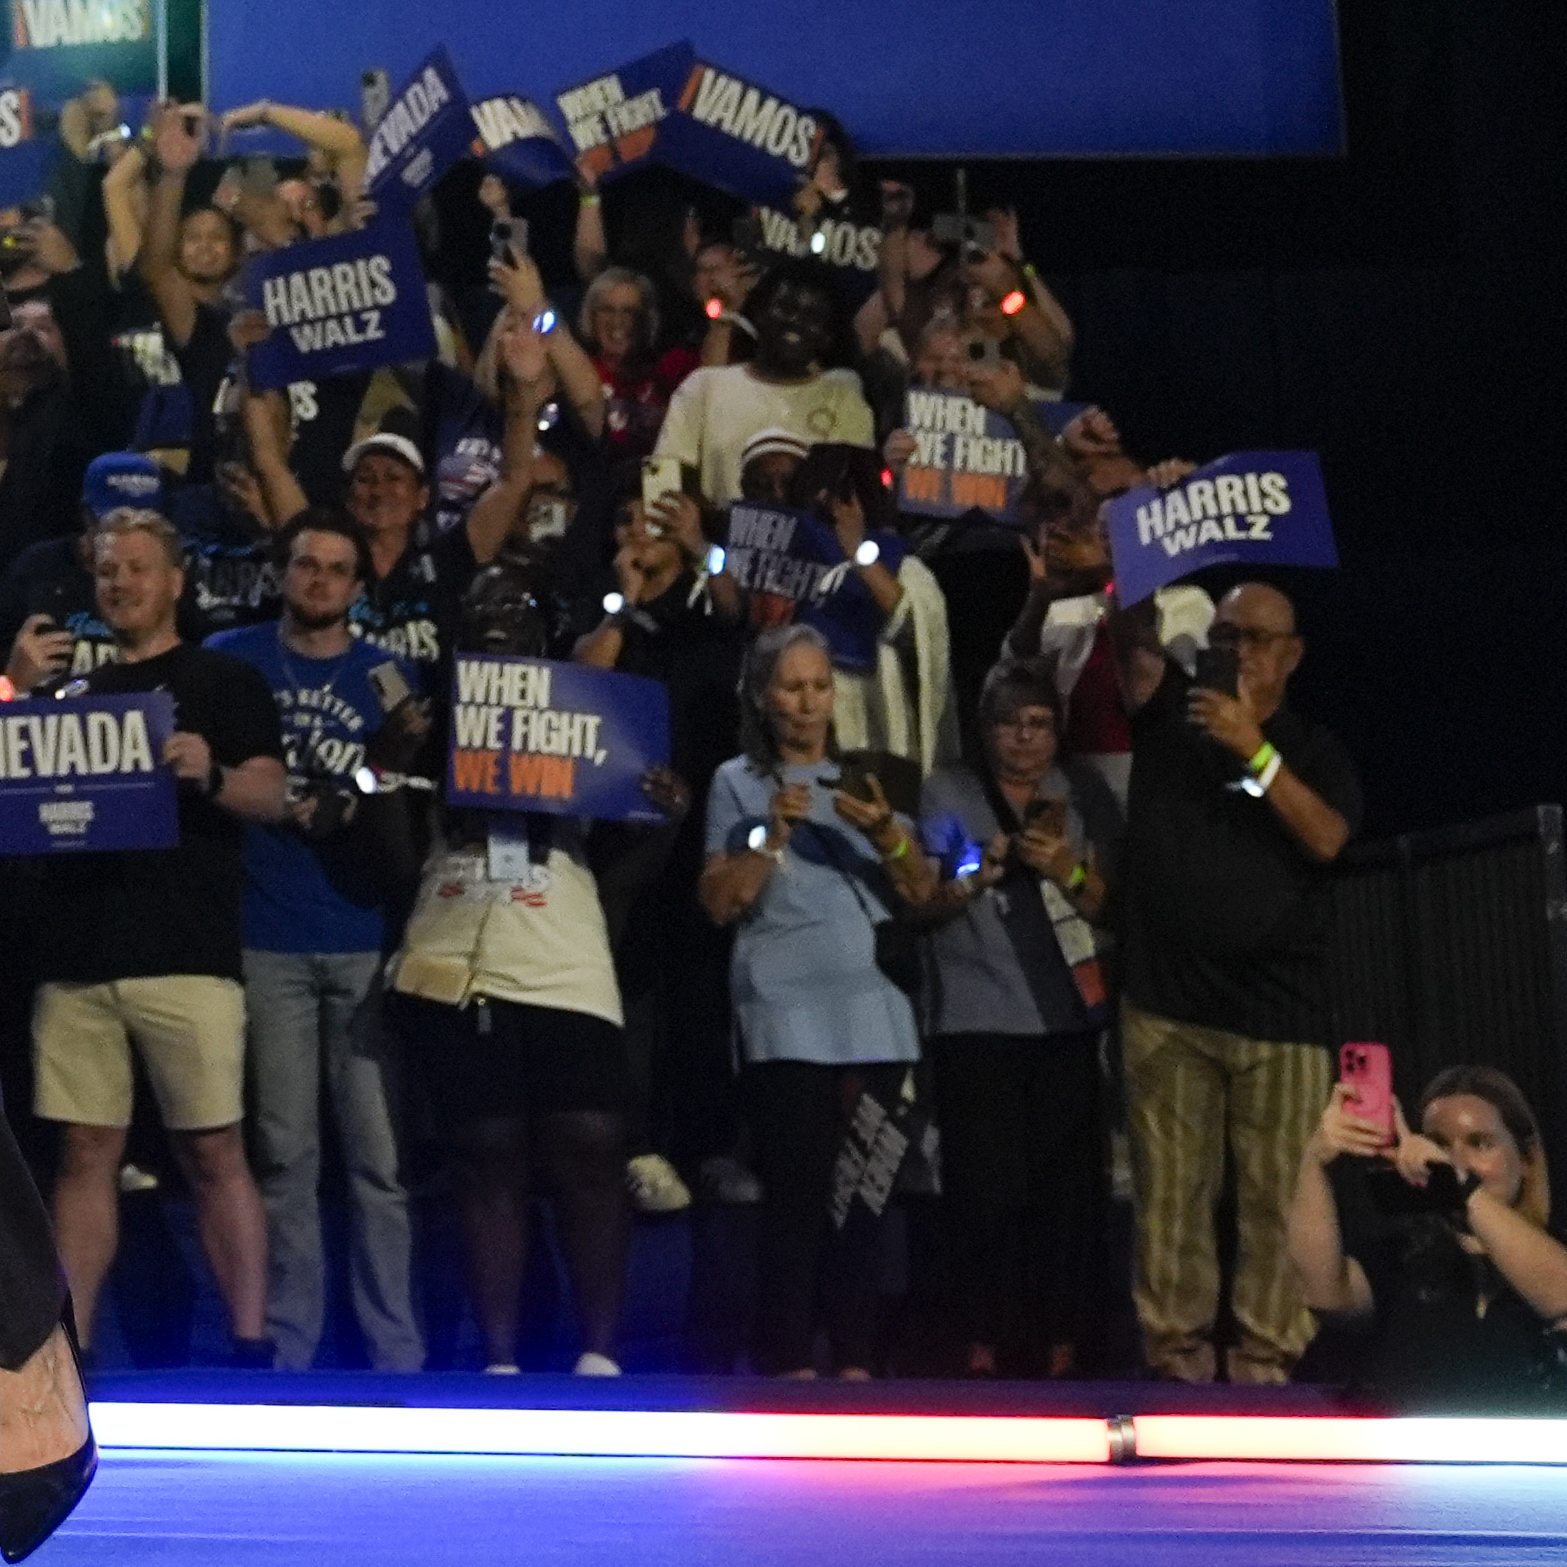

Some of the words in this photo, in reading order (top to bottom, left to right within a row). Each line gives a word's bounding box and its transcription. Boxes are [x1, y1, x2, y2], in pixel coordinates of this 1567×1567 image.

[262, 254, 398, 328] HARRIS
[288, 309, 387, 355] WALZ
[907, 388, 987, 436] WHEN
[1134, 470, 1292, 546] HARRIS
[1160, 513, 1274, 558] WALZ
[457, 659, 553, 708] WHEN
[454, 703, 506, 752] WE
[510, 708, 609, 768] FIGHT,
[453, 749, 502, 795] WE
[509, 752, 575, 800] WIN
